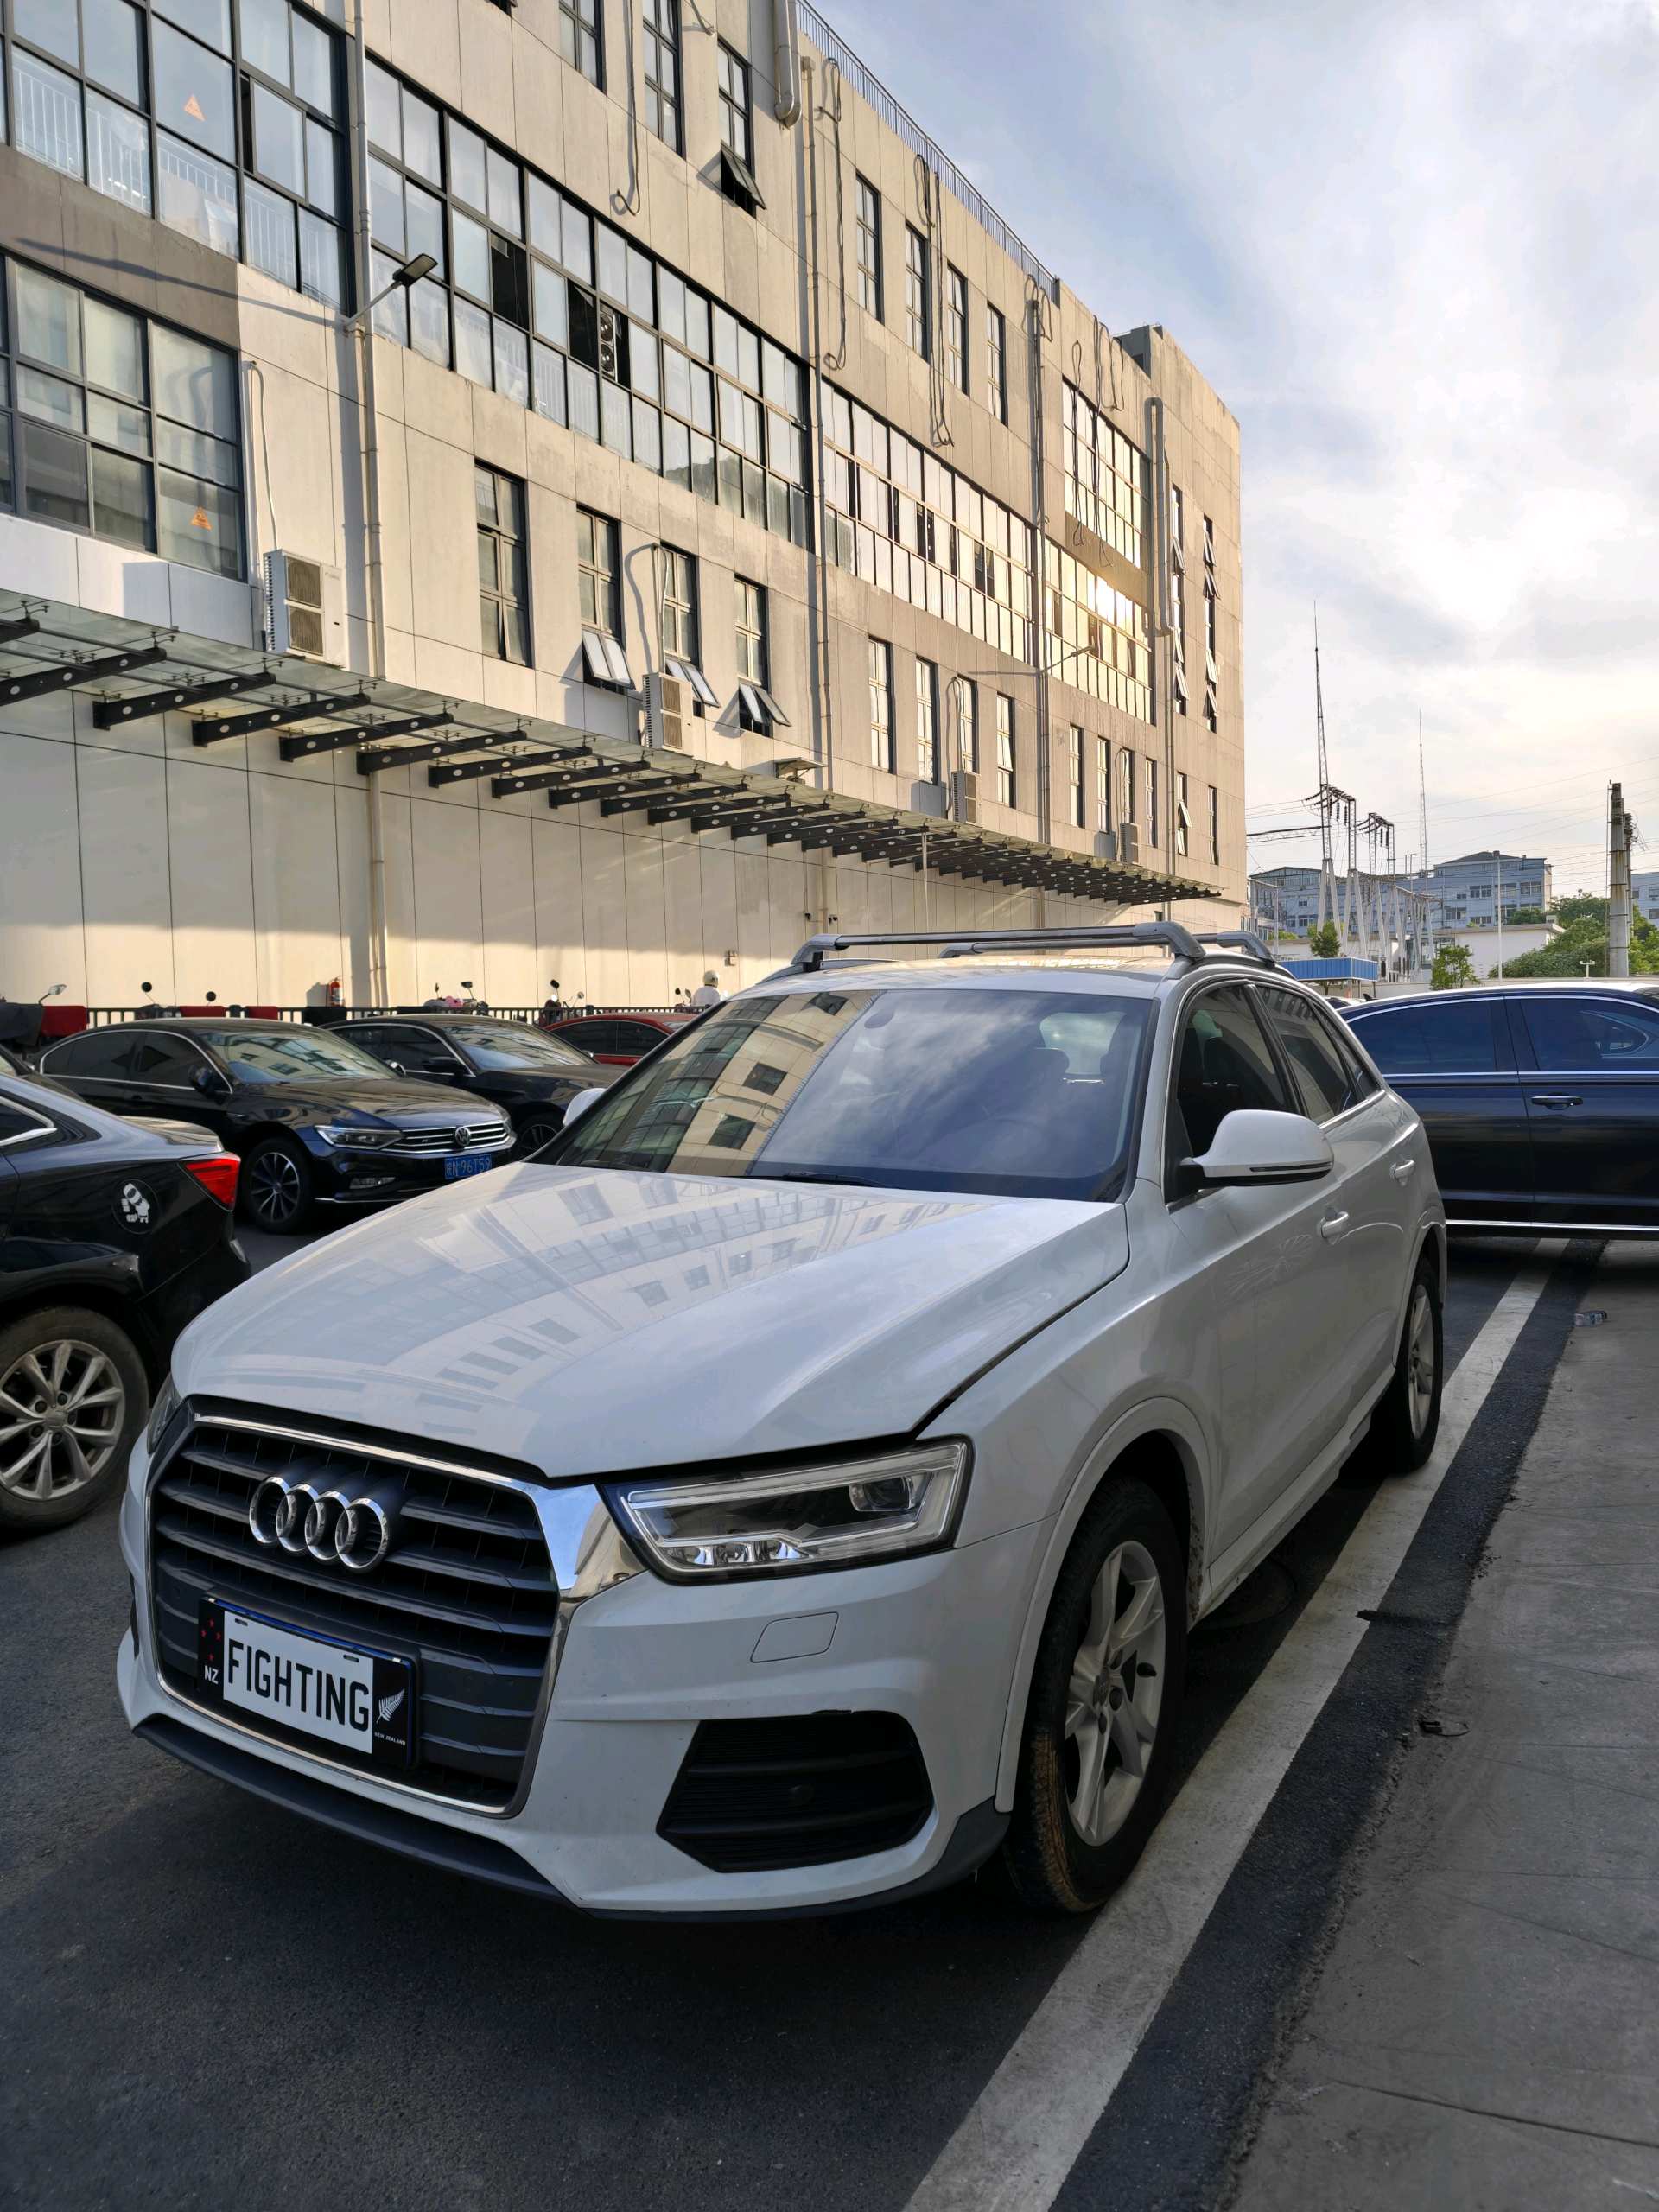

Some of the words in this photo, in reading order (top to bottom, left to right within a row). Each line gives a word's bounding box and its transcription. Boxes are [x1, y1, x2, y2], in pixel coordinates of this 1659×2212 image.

[204, 1665, 219, 1685] NZ
[227, 1638, 370, 1732] FIGHTING
[385, 1735, 406, 1746] ZEALAND
